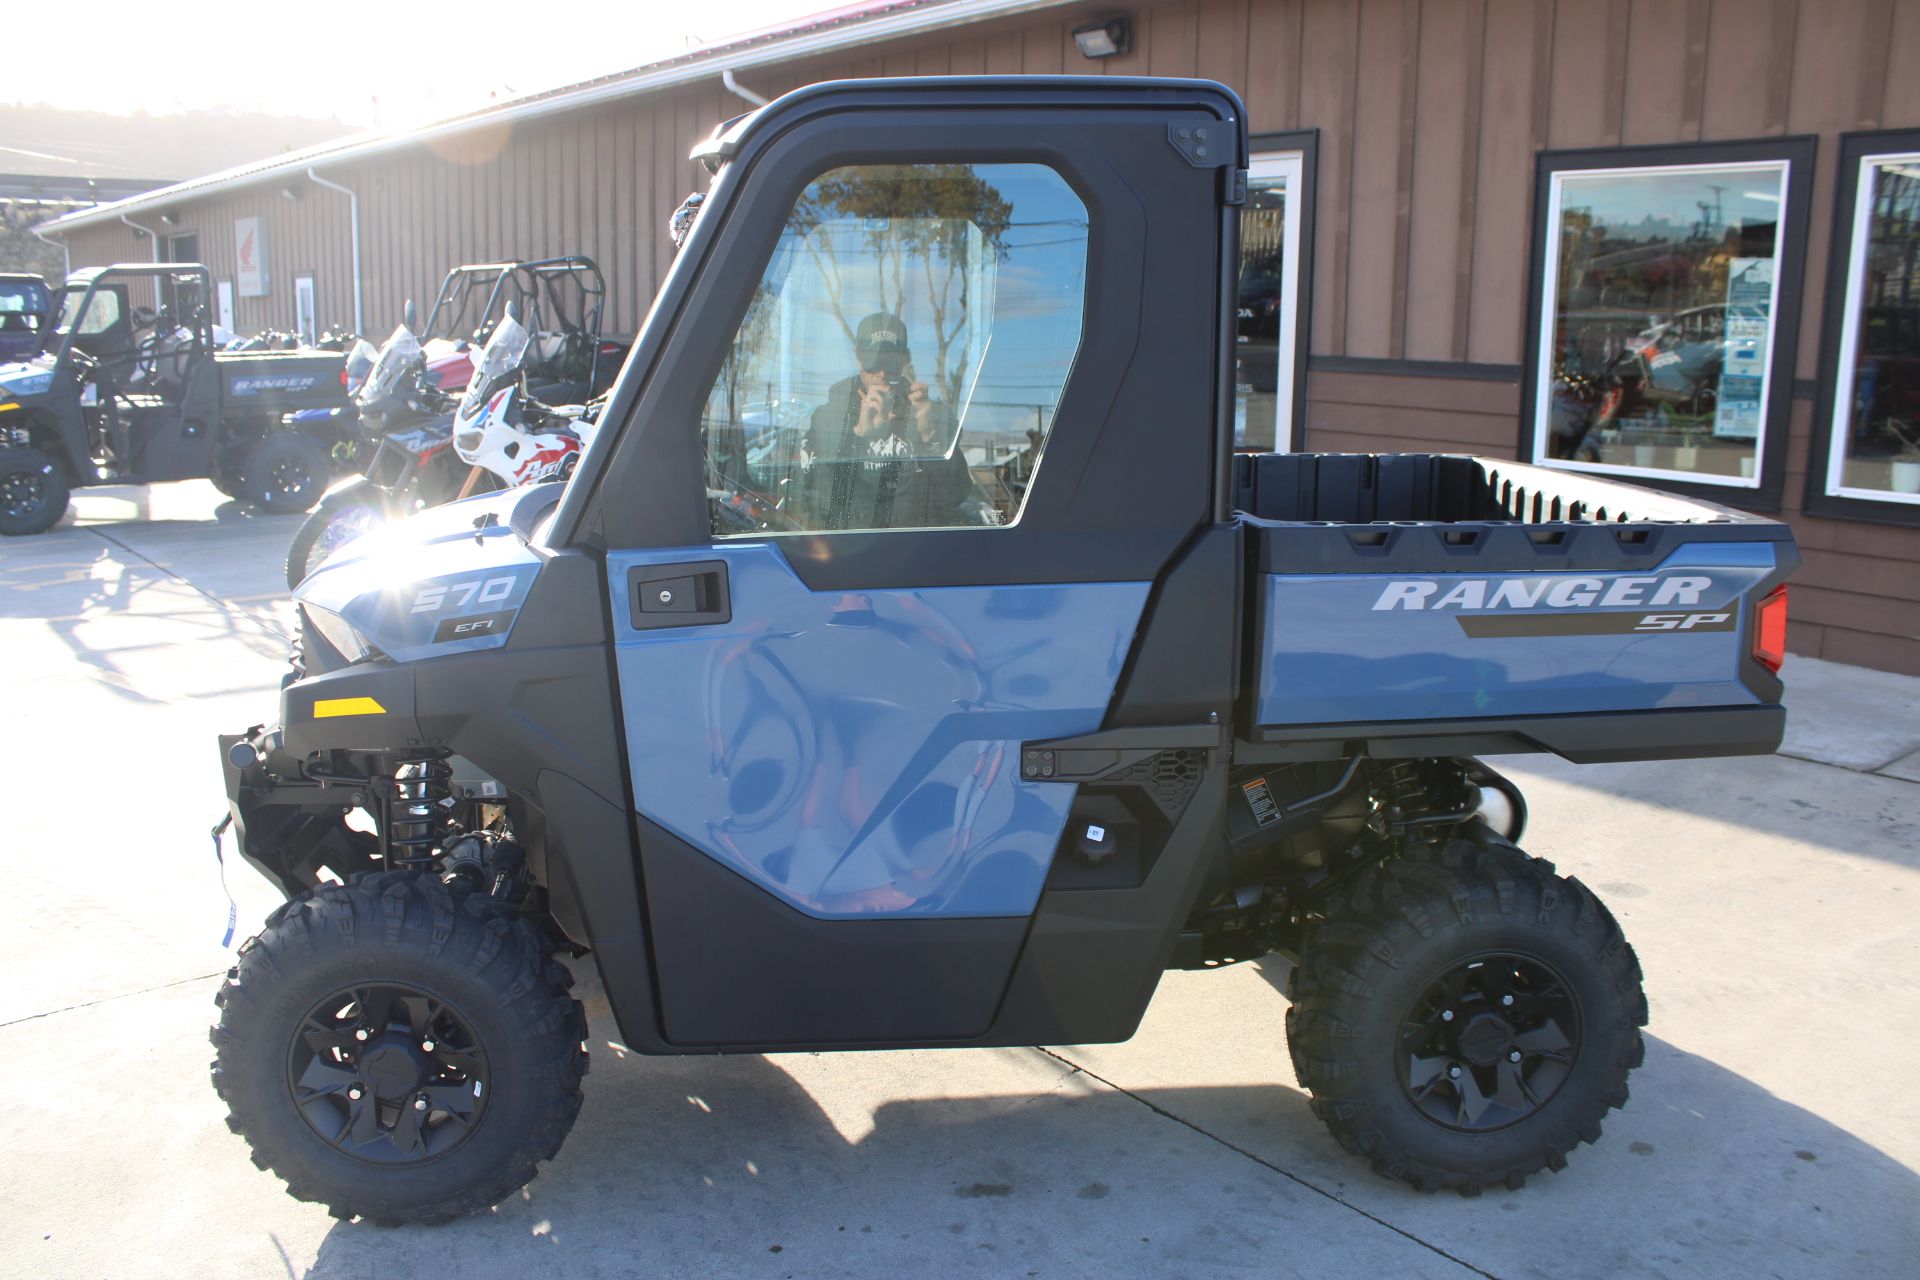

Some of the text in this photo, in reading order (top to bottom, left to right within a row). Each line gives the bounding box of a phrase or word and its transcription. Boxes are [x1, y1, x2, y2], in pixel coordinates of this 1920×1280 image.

[234, 377, 315, 390] RANGER
[410, 575, 517, 614] 570
[1372, 576, 1712, 611] RANGER
[454, 619, 494, 633] EFI
[1634, 612, 1730, 630] SP
